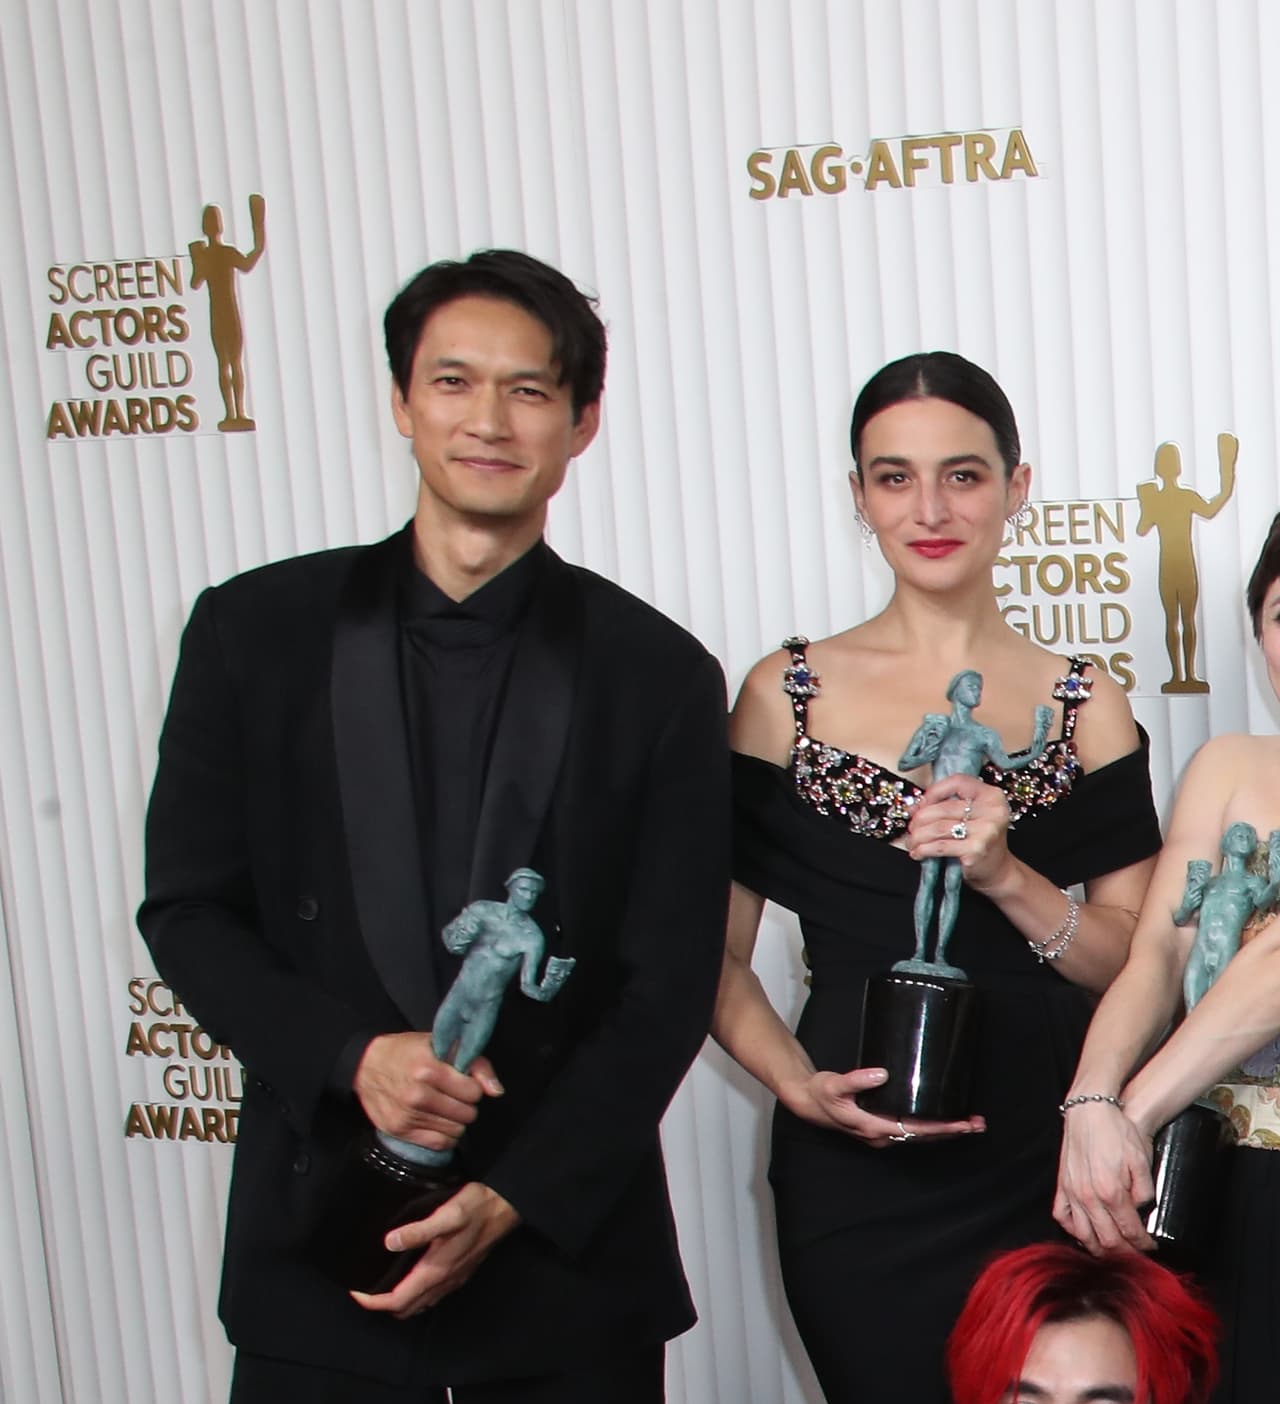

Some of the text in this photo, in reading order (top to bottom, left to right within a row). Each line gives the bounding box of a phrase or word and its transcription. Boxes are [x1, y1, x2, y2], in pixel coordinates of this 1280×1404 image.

[48, 259, 184, 305] SCREEN
[46, 304, 190, 349] ACTORS
[86, 351, 193, 392] GUILD
[47, 394, 200, 439] AWARDS
[1000, 502, 1125, 546] REEN
[992, 552, 1131, 597] CTORS
[126, 1022, 233, 1060] ACTO
[163, 1064, 248, 1102] GUIL
[125, 1103, 241, 1143] AWARD
